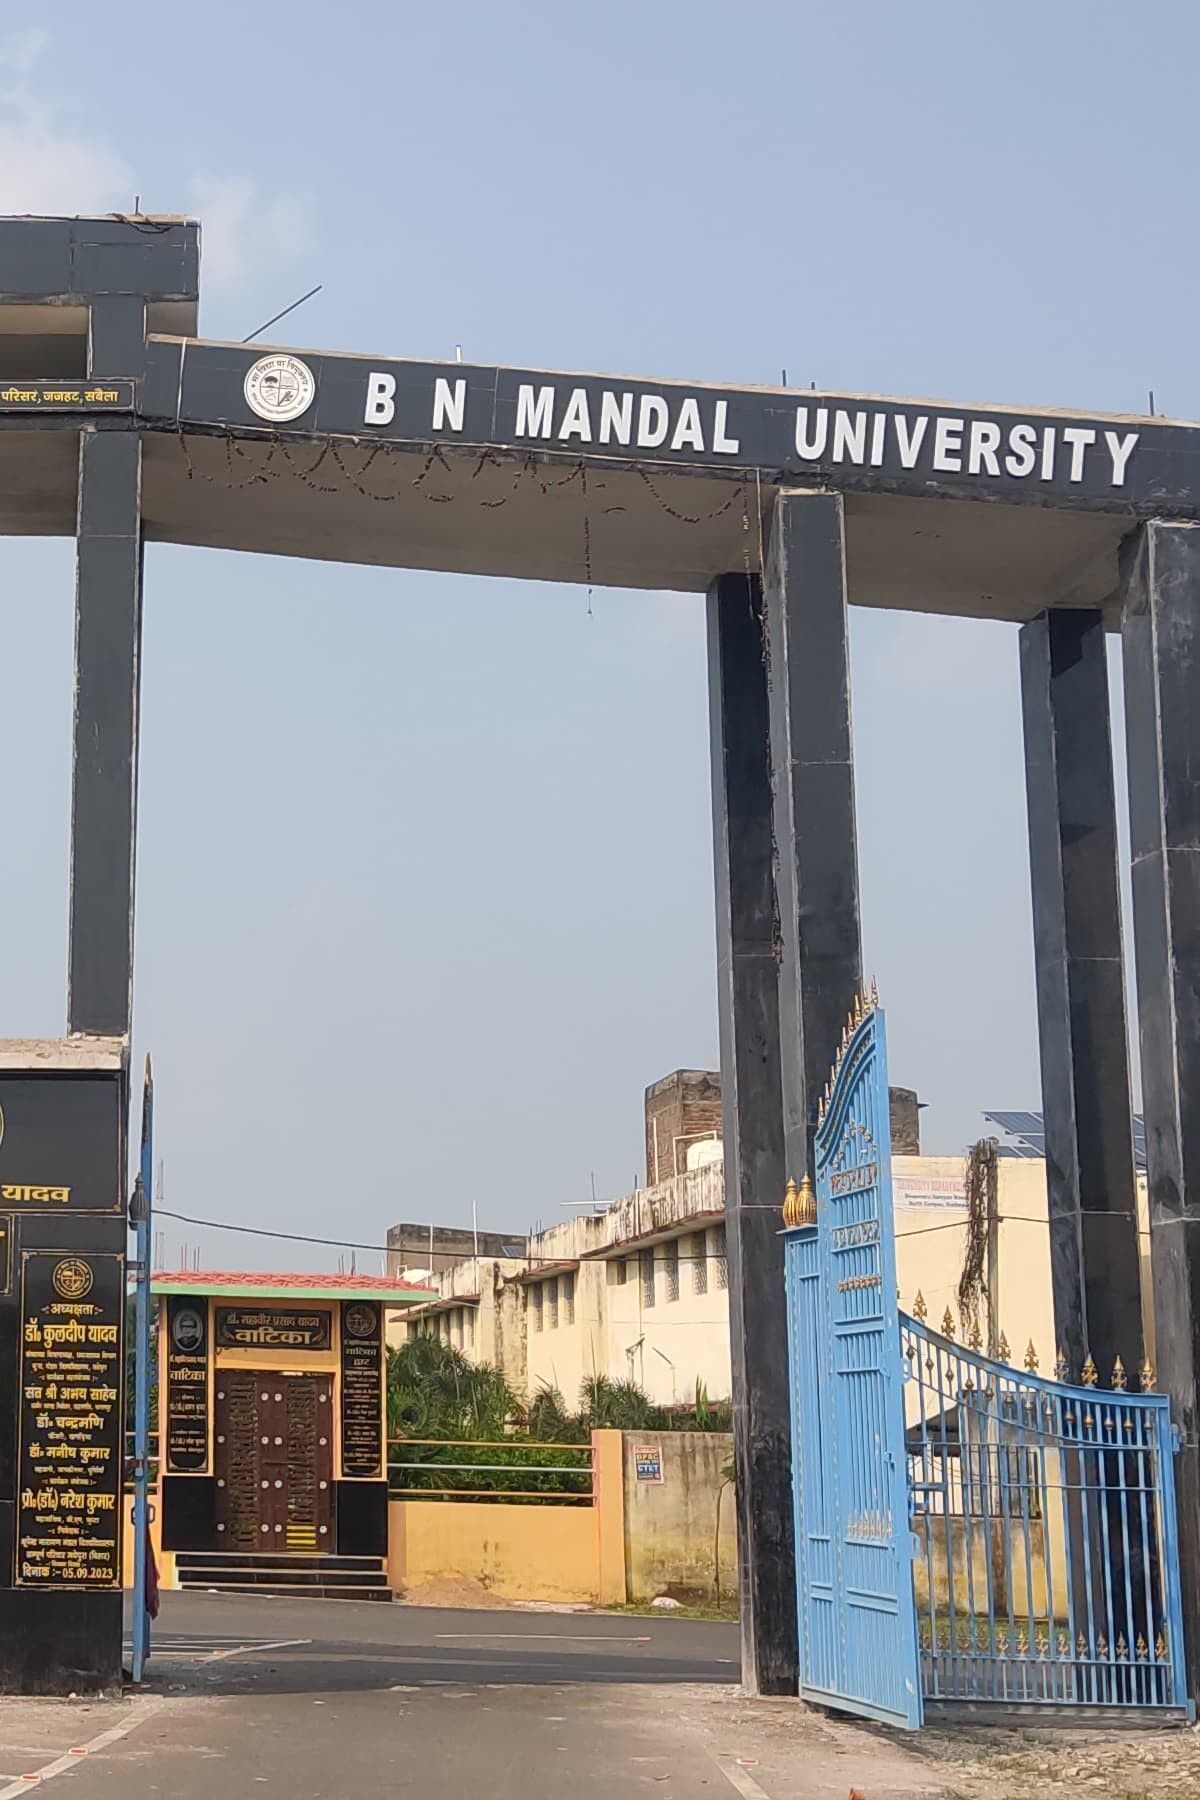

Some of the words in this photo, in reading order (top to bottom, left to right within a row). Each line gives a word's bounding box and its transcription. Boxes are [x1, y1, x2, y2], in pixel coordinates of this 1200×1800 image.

[364, 372, 395, 425] B
[432, 378, 466, 433] N
[515, 385, 740, 455] MANDAL
[795, 406, 1140, 487] UNIVERSITY
[1, 1185, 71, 1202] यादव
[43, 1319, 87, 1348] कुलदीप
[88, 1324, 118, 1343] यादव
[235, 1326, 312, 1344] वाटिका
[79, 1447, 111, 1463] कुमार
[60, 1489, 85, 1510] नरेश
[86, 1492, 115, 1514] कुमार
[62, 1567, 113, 1579] 05.09.2023
